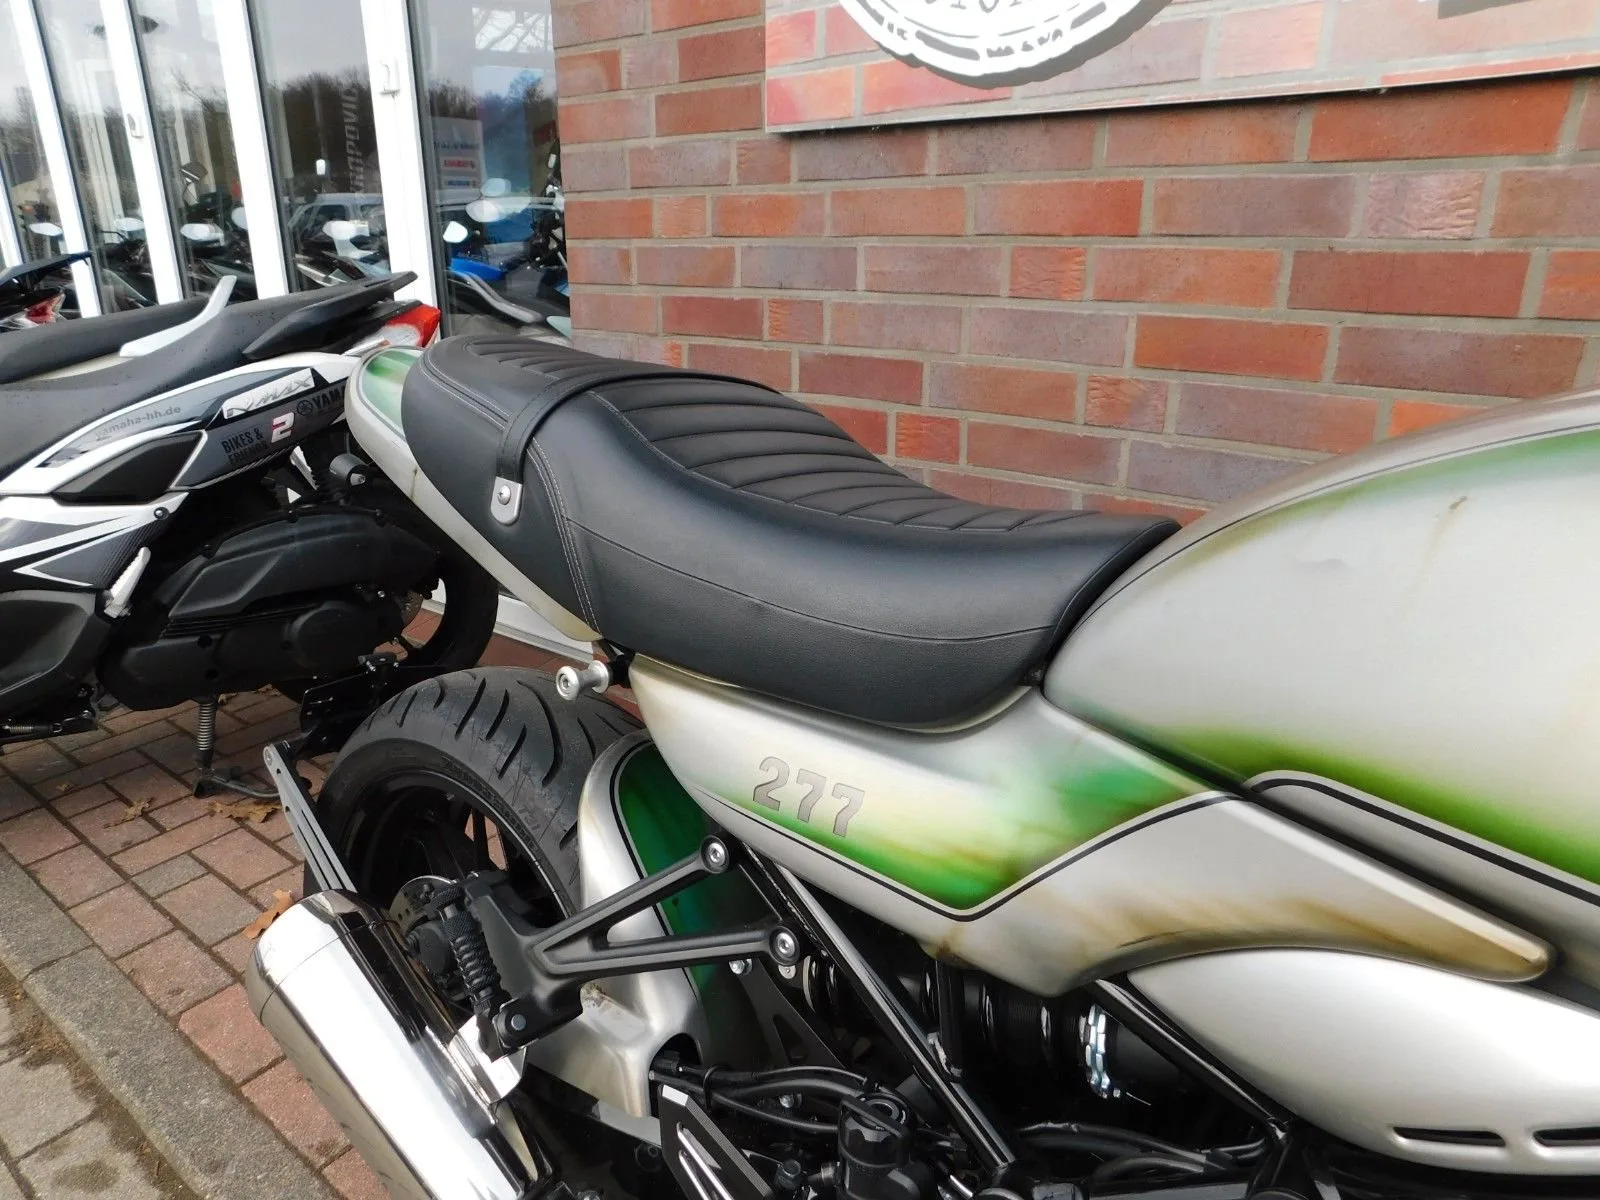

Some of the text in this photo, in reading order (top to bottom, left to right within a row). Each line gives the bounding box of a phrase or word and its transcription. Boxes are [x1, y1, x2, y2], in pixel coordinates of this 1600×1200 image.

[221, 427, 265, 454] BIKES &
[753, 756, 865, 837] 277
